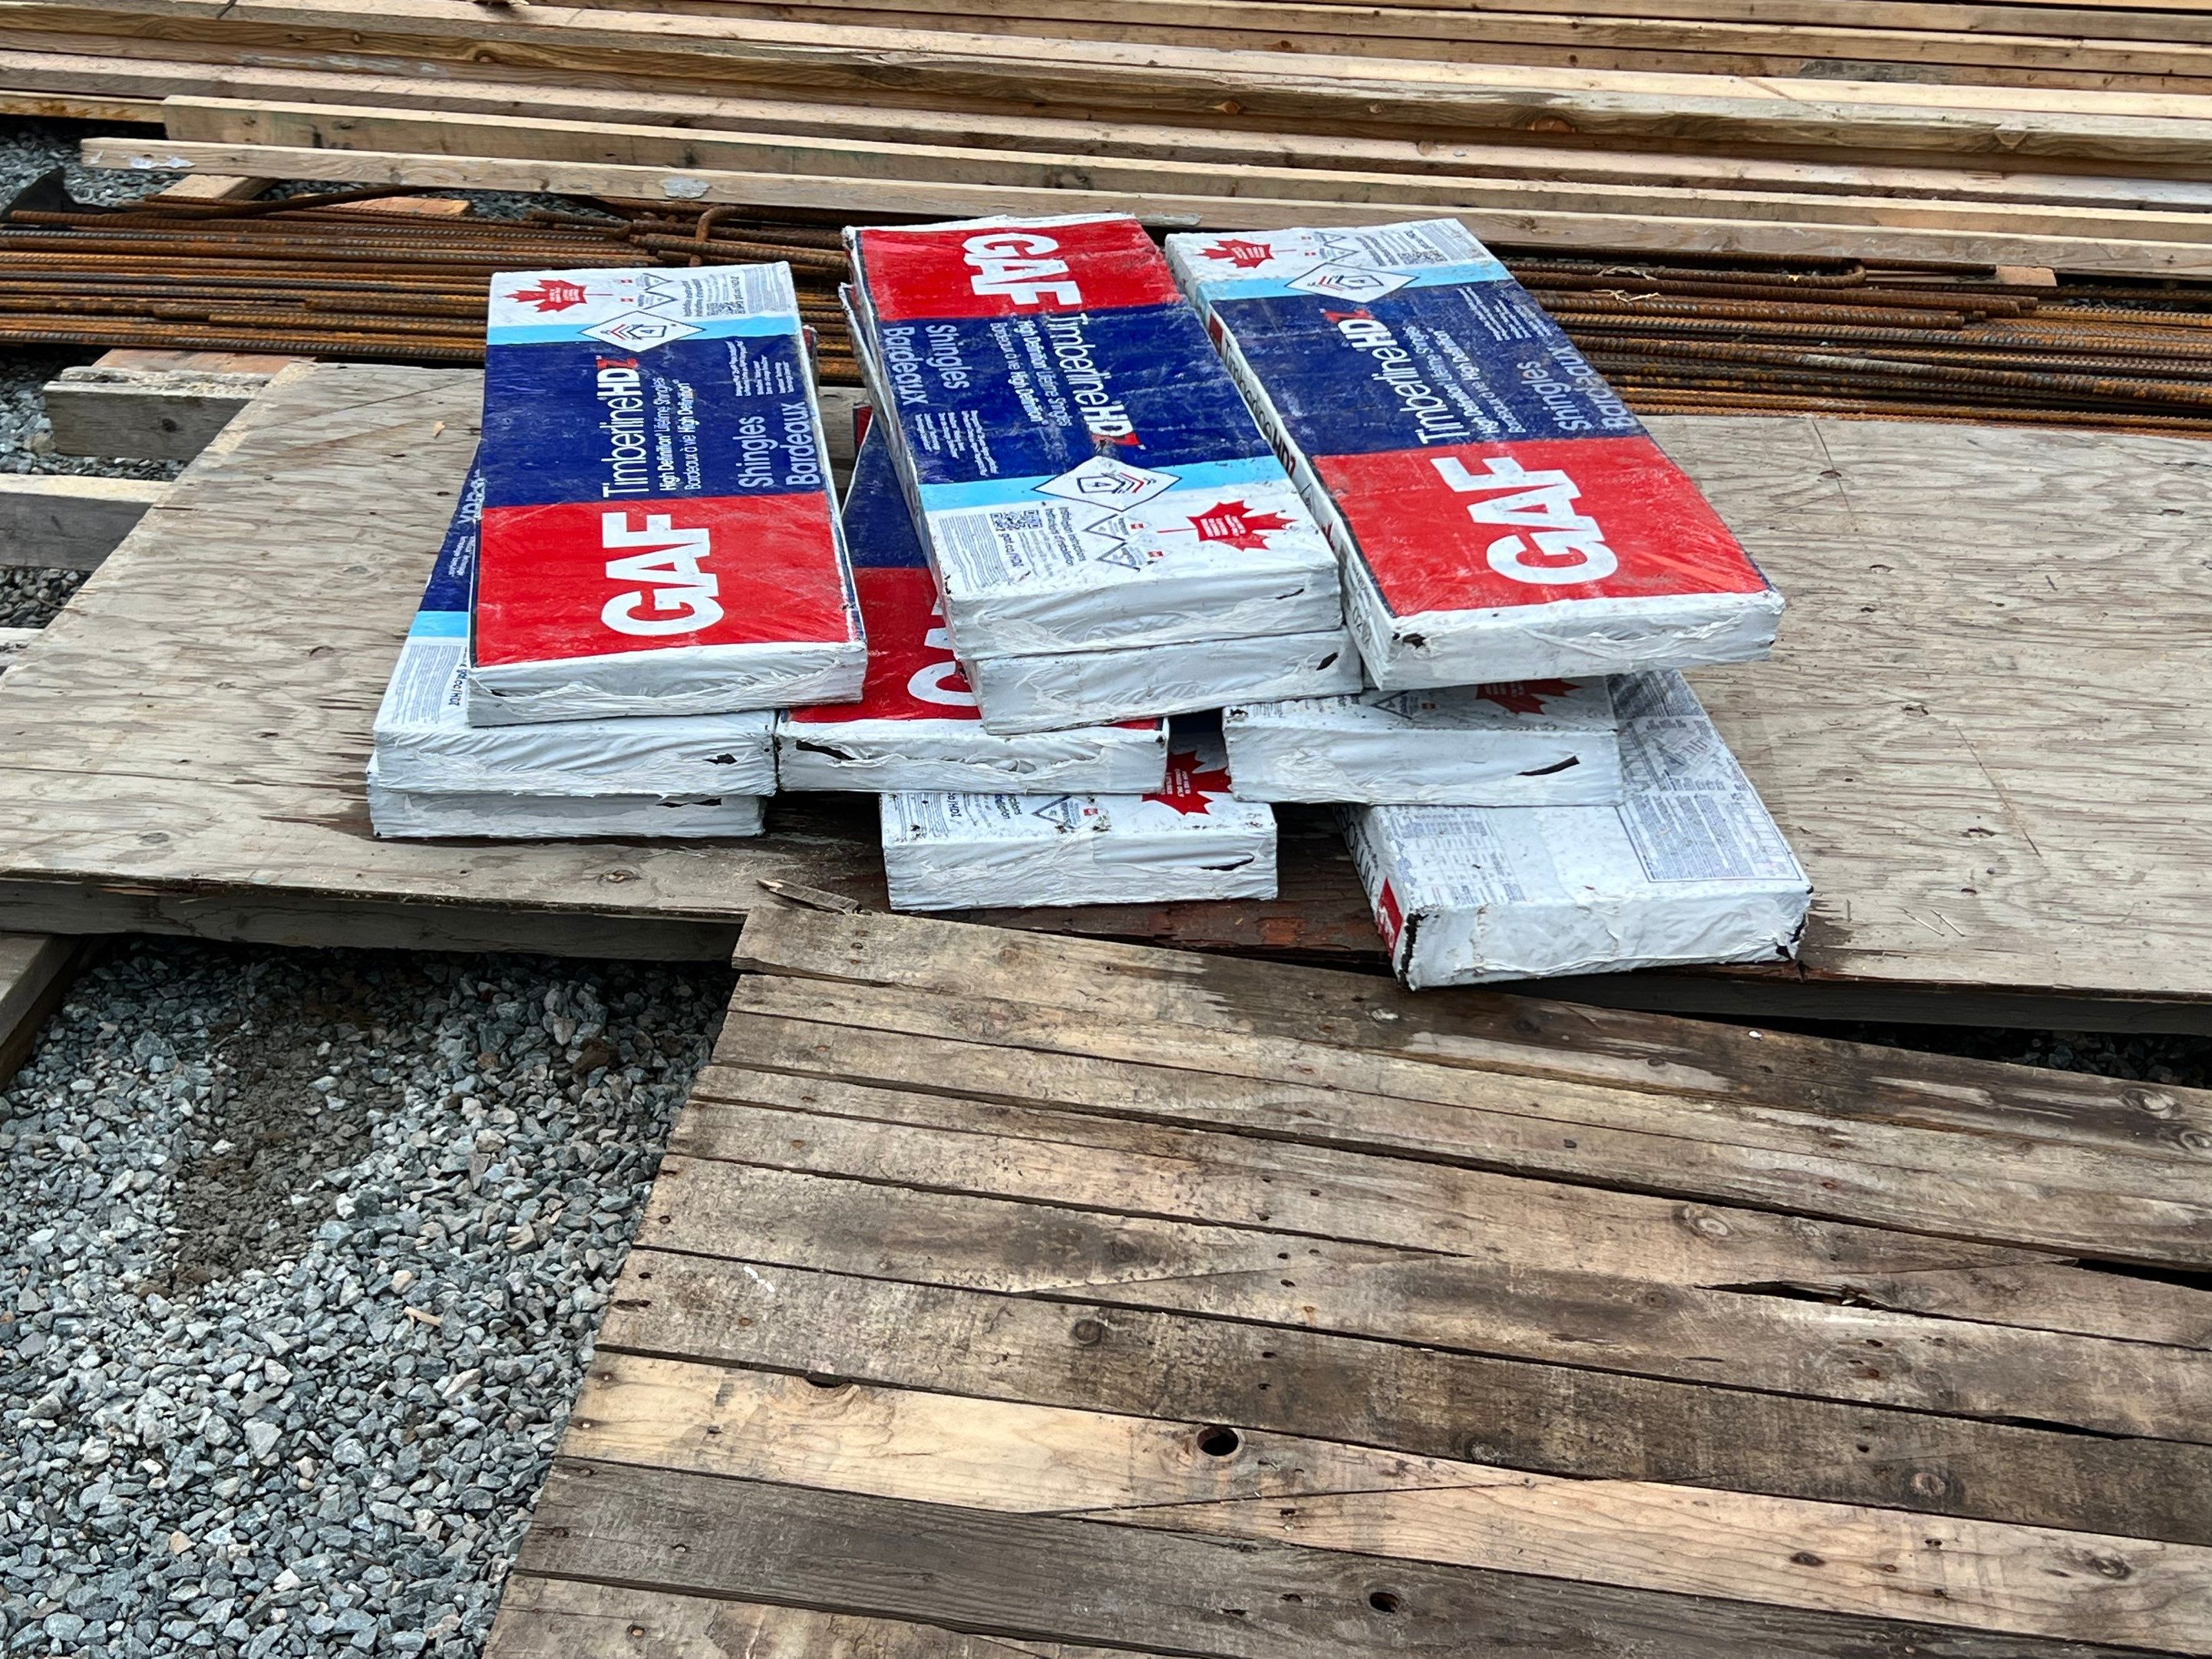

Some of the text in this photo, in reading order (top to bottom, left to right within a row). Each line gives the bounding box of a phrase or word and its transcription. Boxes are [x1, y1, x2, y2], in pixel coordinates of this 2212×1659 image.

[962, 233, 1083, 306] GAF
[882, 326, 929, 406] Bardeaux
[925, 325, 973, 389] Shingles
[989, 322, 1015, 354] Bardeaux
[1007, 371, 1030, 389] High
[1401, 325, 1434, 355] Shingles
[1455, 362, 1481, 381] High
[651, 377, 673, 405] Shingles
[1013, 319, 1038, 337] High
[1047, 397, 1073, 428] Shingles
[1517, 360, 1593, 431] Shingles
[1550, 346, 1634, 430] Bardeaux
[653, 406, 672, 433] Lifetime
[677, 416, 700, 433] High
[682, 434, 697, 447] vie
[732, 416, 779, 487] Shingles
[779, 401, 821, 486] Bardeaux
[1471, 416, 1501, 434] High
[658, 471, 681, 491] High
[683, 453, 702, 490] Bardeaux
[1431, 455, 1619, 586] GAF
[601, 511, 725, 636] GAF
